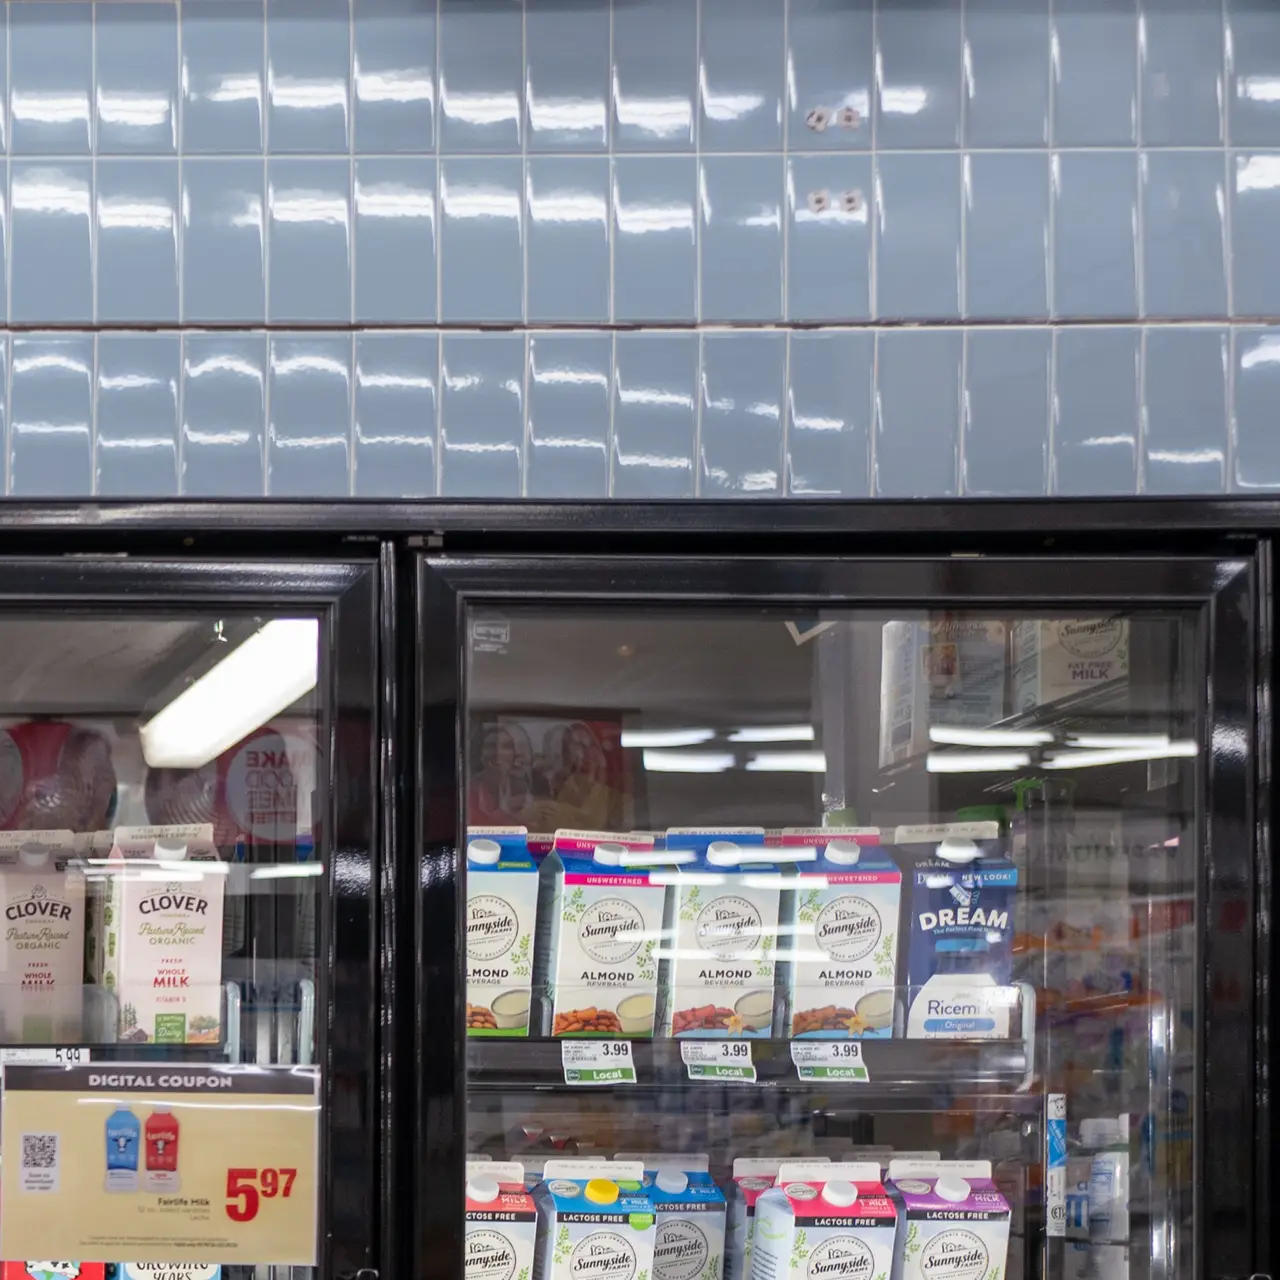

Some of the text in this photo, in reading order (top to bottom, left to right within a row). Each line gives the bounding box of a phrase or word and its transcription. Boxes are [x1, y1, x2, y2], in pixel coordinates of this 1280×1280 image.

[1072, 670, 1109, 680] MILK
[140, 896, 208, 915] CLOVER
[919, 908, 1008, 931] DREAM
[153, 976, 189, 988] MILK
[581, 972, 634, 981] ALMOND
[945, 1020, 976, 1030] Original
[602, 1044, 628, 1056] 3.99
[832, 1045, 858, 1056] 3.99
[89, 1075, 231, 1088] DIGITAL COUPON
[574, 1255, 632, 1272] Sunnyside
